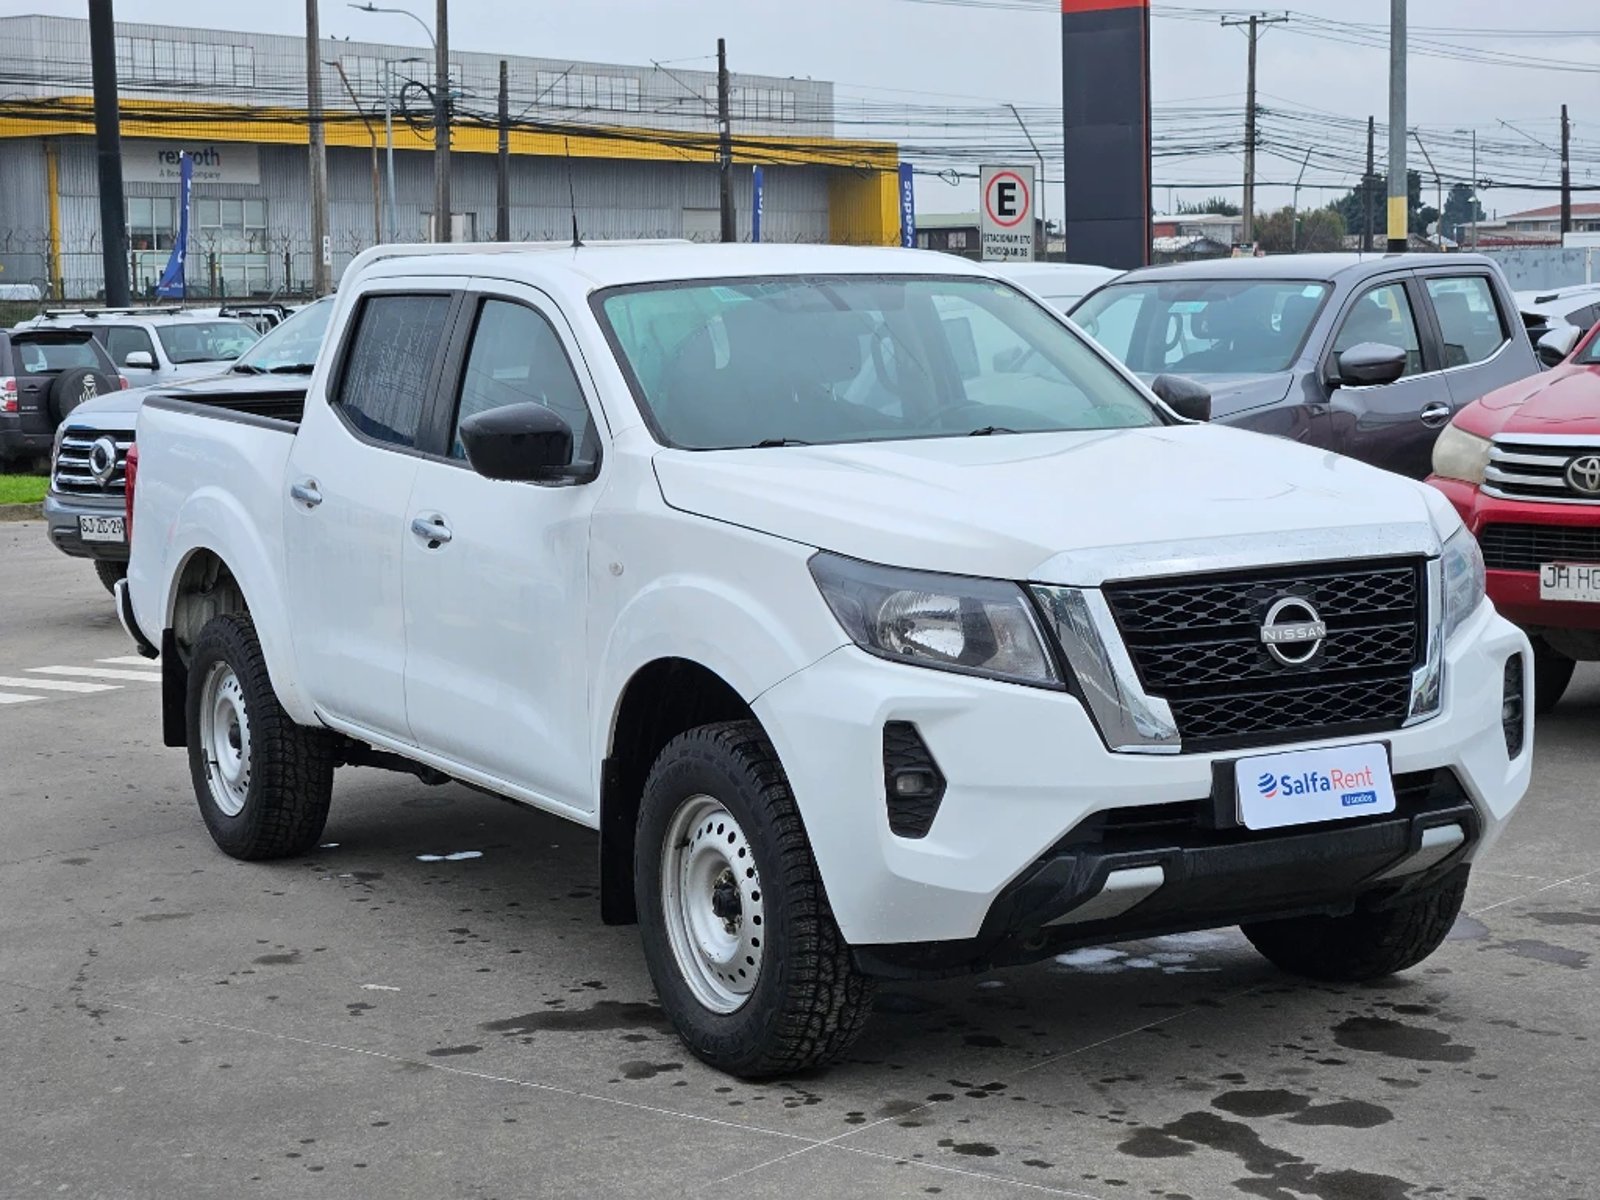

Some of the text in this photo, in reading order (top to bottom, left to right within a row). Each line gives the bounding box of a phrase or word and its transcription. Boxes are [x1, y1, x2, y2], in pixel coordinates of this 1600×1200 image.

[158, 146, 220, 166] rexoth
[192, 170, 220, 180] ompany
[997, 182, 1016, 216] E
[1263, 626, 1326, 640] NISSAN
